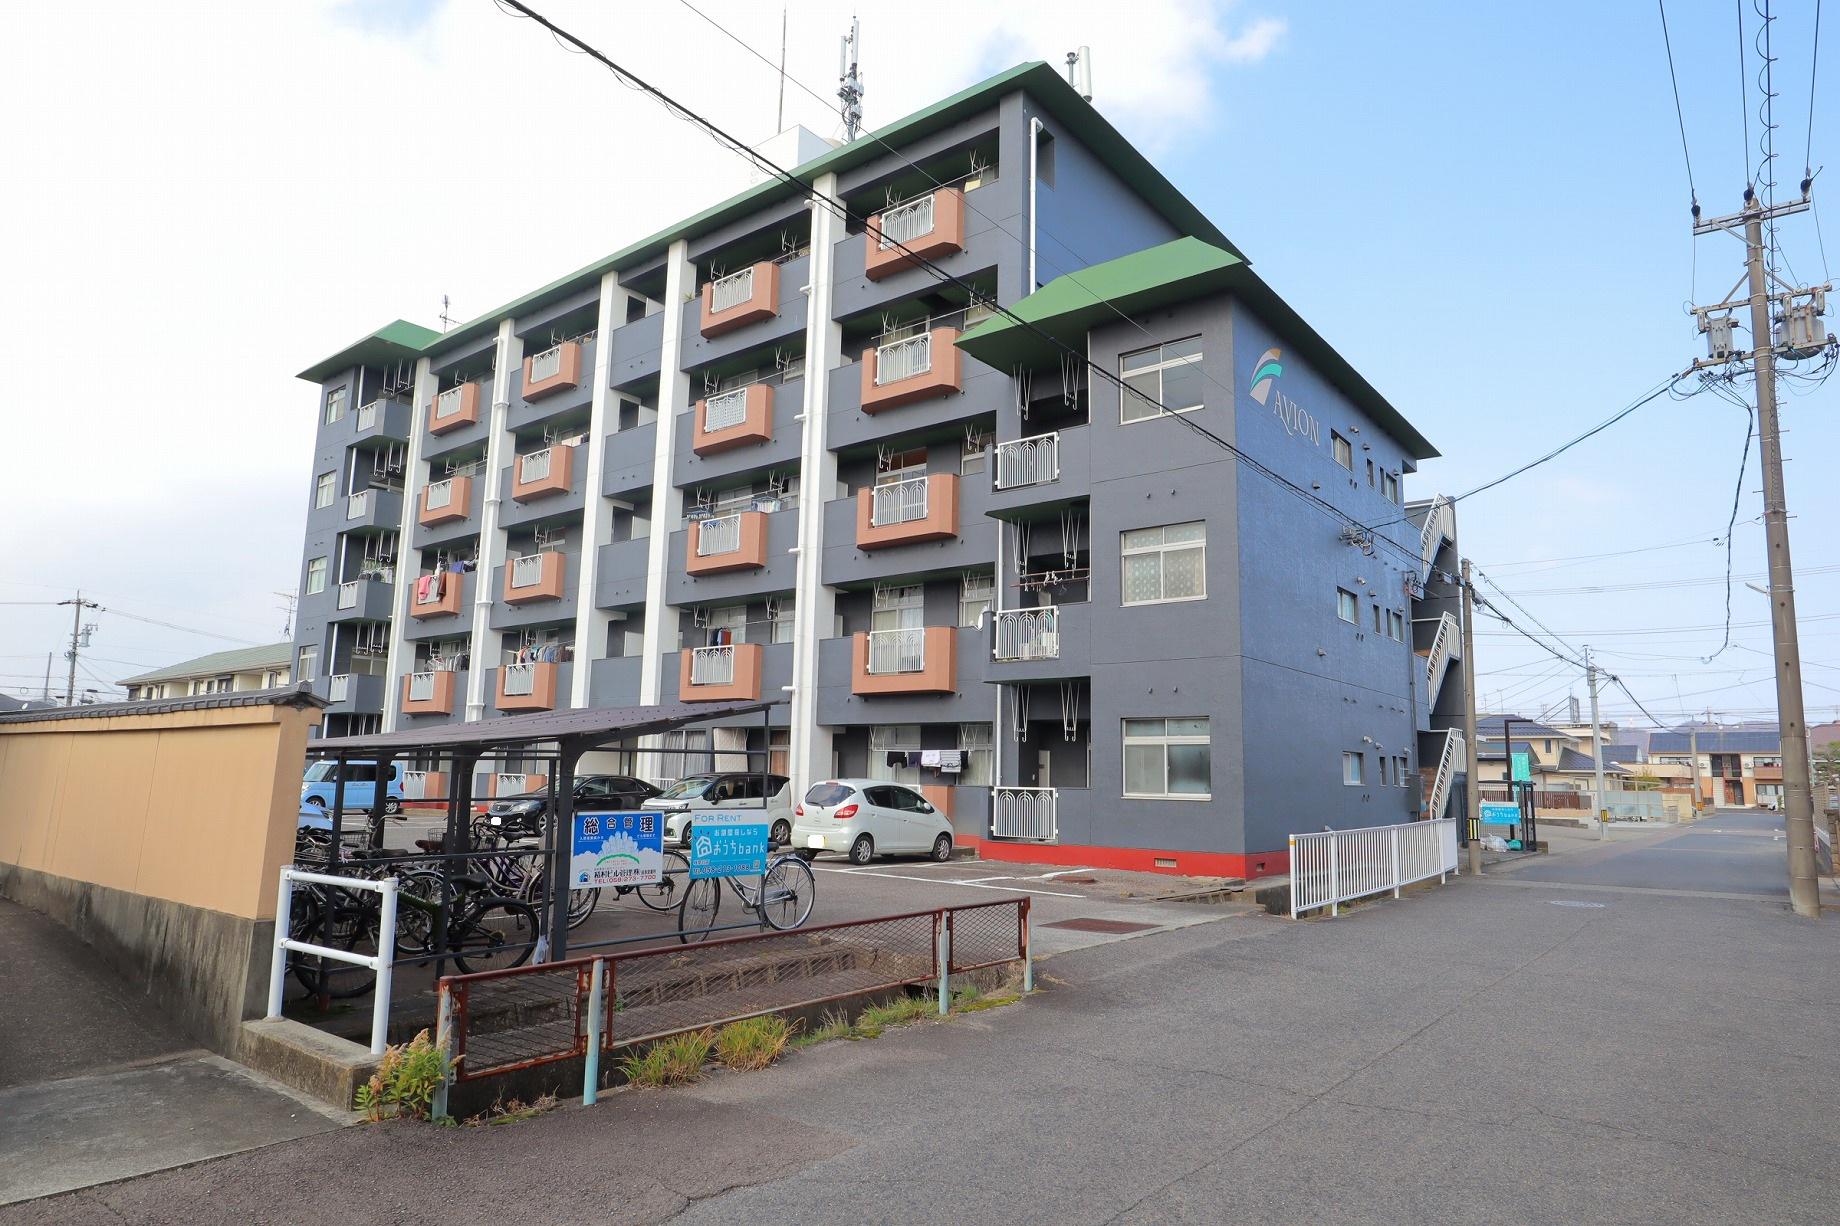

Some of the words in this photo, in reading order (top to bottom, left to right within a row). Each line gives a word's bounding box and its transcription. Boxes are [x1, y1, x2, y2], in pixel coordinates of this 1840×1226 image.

[1273, 390, 1319, 446] AVION
[583, 816, 654, 835] 総合管理
[694, 814, 715, 823] FOR
[717, 813, 742, 822] RENT
[713, 839, 765, 856] おうちbank
